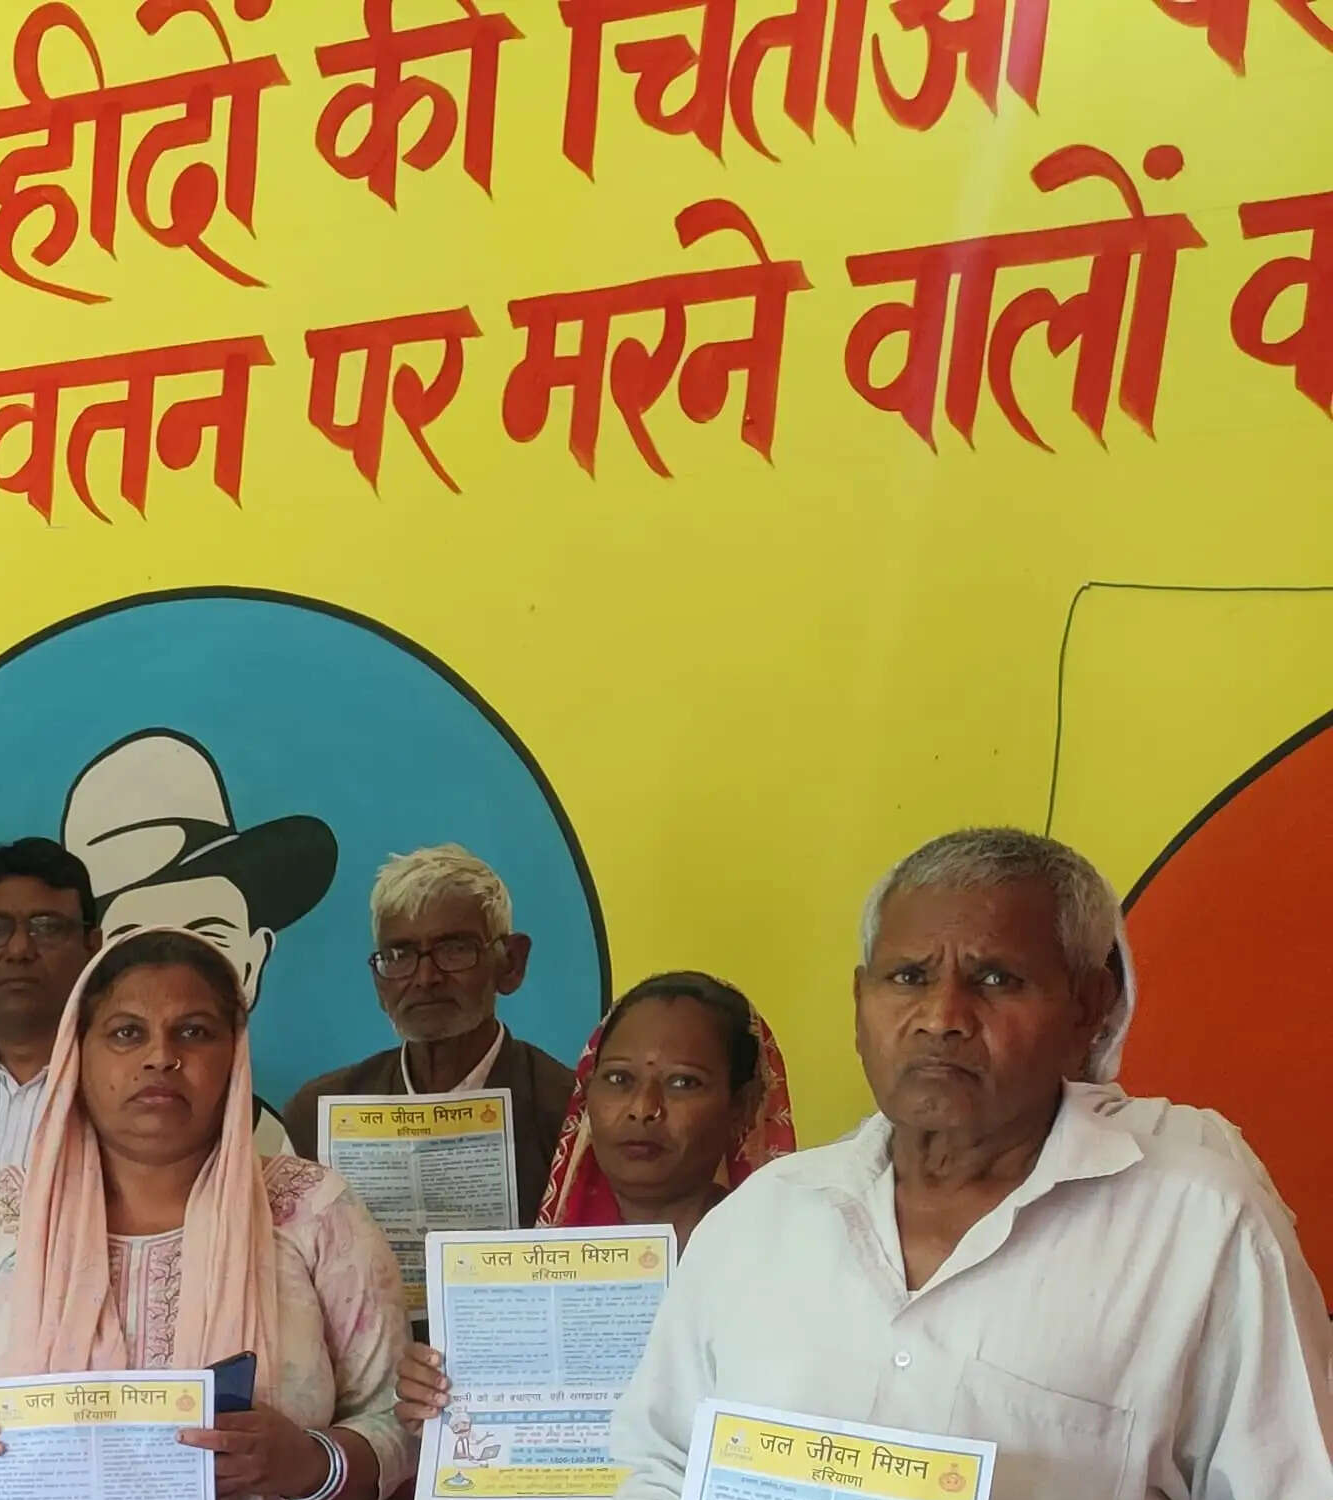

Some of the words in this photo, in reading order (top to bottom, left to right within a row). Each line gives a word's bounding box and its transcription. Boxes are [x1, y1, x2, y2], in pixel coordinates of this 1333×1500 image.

[305, 305, 483, 499] पर
[501, 198, 815, 481] मरने
[844, 144, 1208, 457] वालों
[359, 1111, 383, 1125] जल
[390, 1106, 425, 1125] जीवन
[433, 1105, 473, 1124] मिशन
[481, 1250, 512, 1267] जल
[523, 1244, 570, 1267] जीवन
[582, 1243, 630, 1265] मिशन
[25, 1392, 55, 1409] जल
[65, 1385, 111, 1408] जीवन
[120, 1384, 167, 1406] मिशन
[759, 1432, 794, 1456] जल
[806, 1436, 860, 1468] जीवन
[871, 1445, 930, 1480] मिशन
[811, 1466, 864, 1488] हरियाणा
